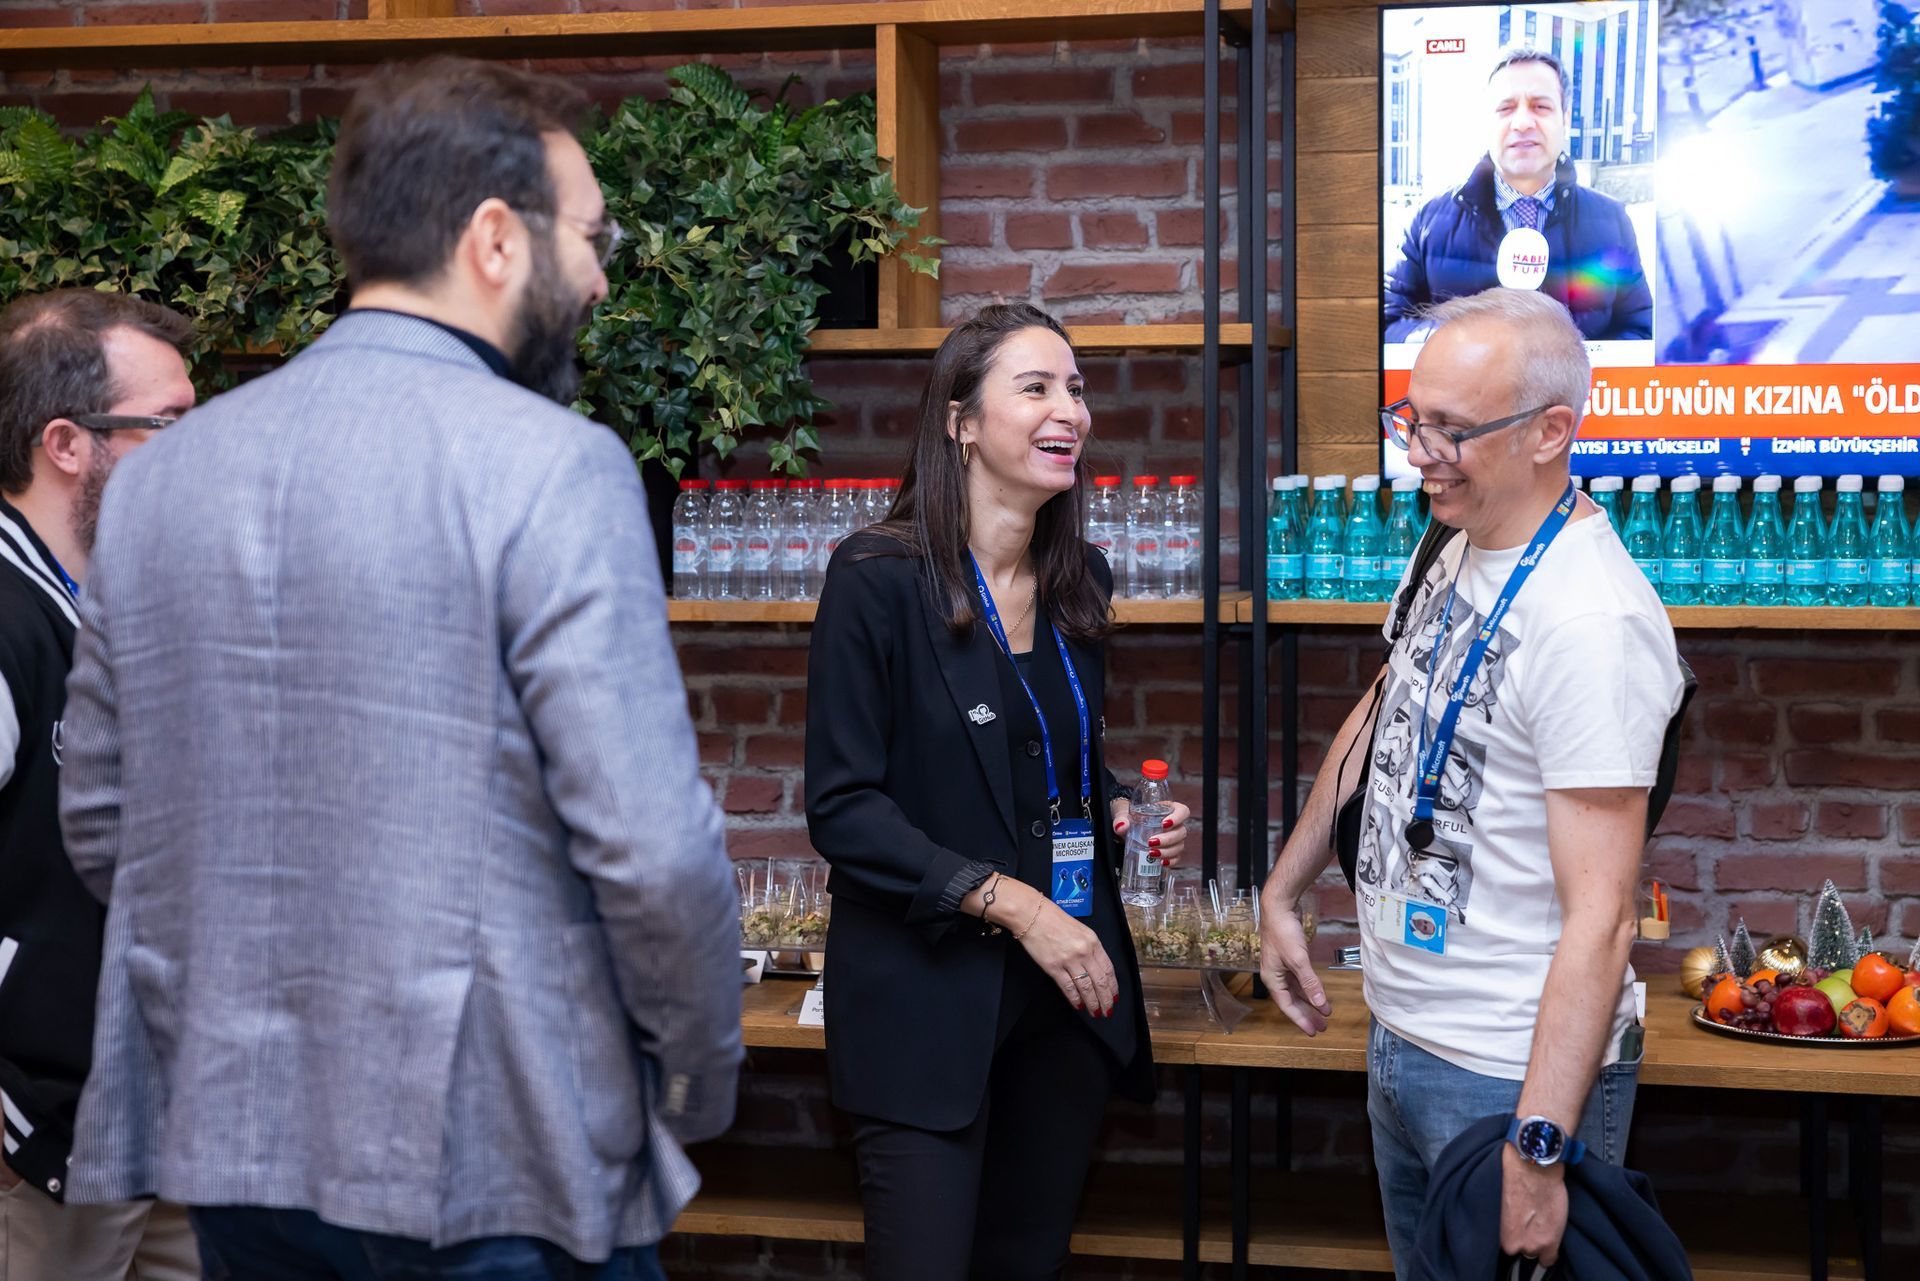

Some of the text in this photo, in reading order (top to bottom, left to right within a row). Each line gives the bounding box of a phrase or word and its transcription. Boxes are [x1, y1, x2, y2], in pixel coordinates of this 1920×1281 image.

[1427, 40, 1464, 53] CANLI
[1744, 385, 1845, 415] KIZINA
[1570, 440, 1608, 455] AYISI
[1645, 437, 1720, 455] YÜKSELDİ
[1772, 436, 1919, 456] İZMİR BÜYÜKŞEHİR
[1486, 597, 1508, 631] Microsoft
[1430, 740, 1446, 774] Microsoft
[1056, 848, 1088, 857] MICROSOFT
